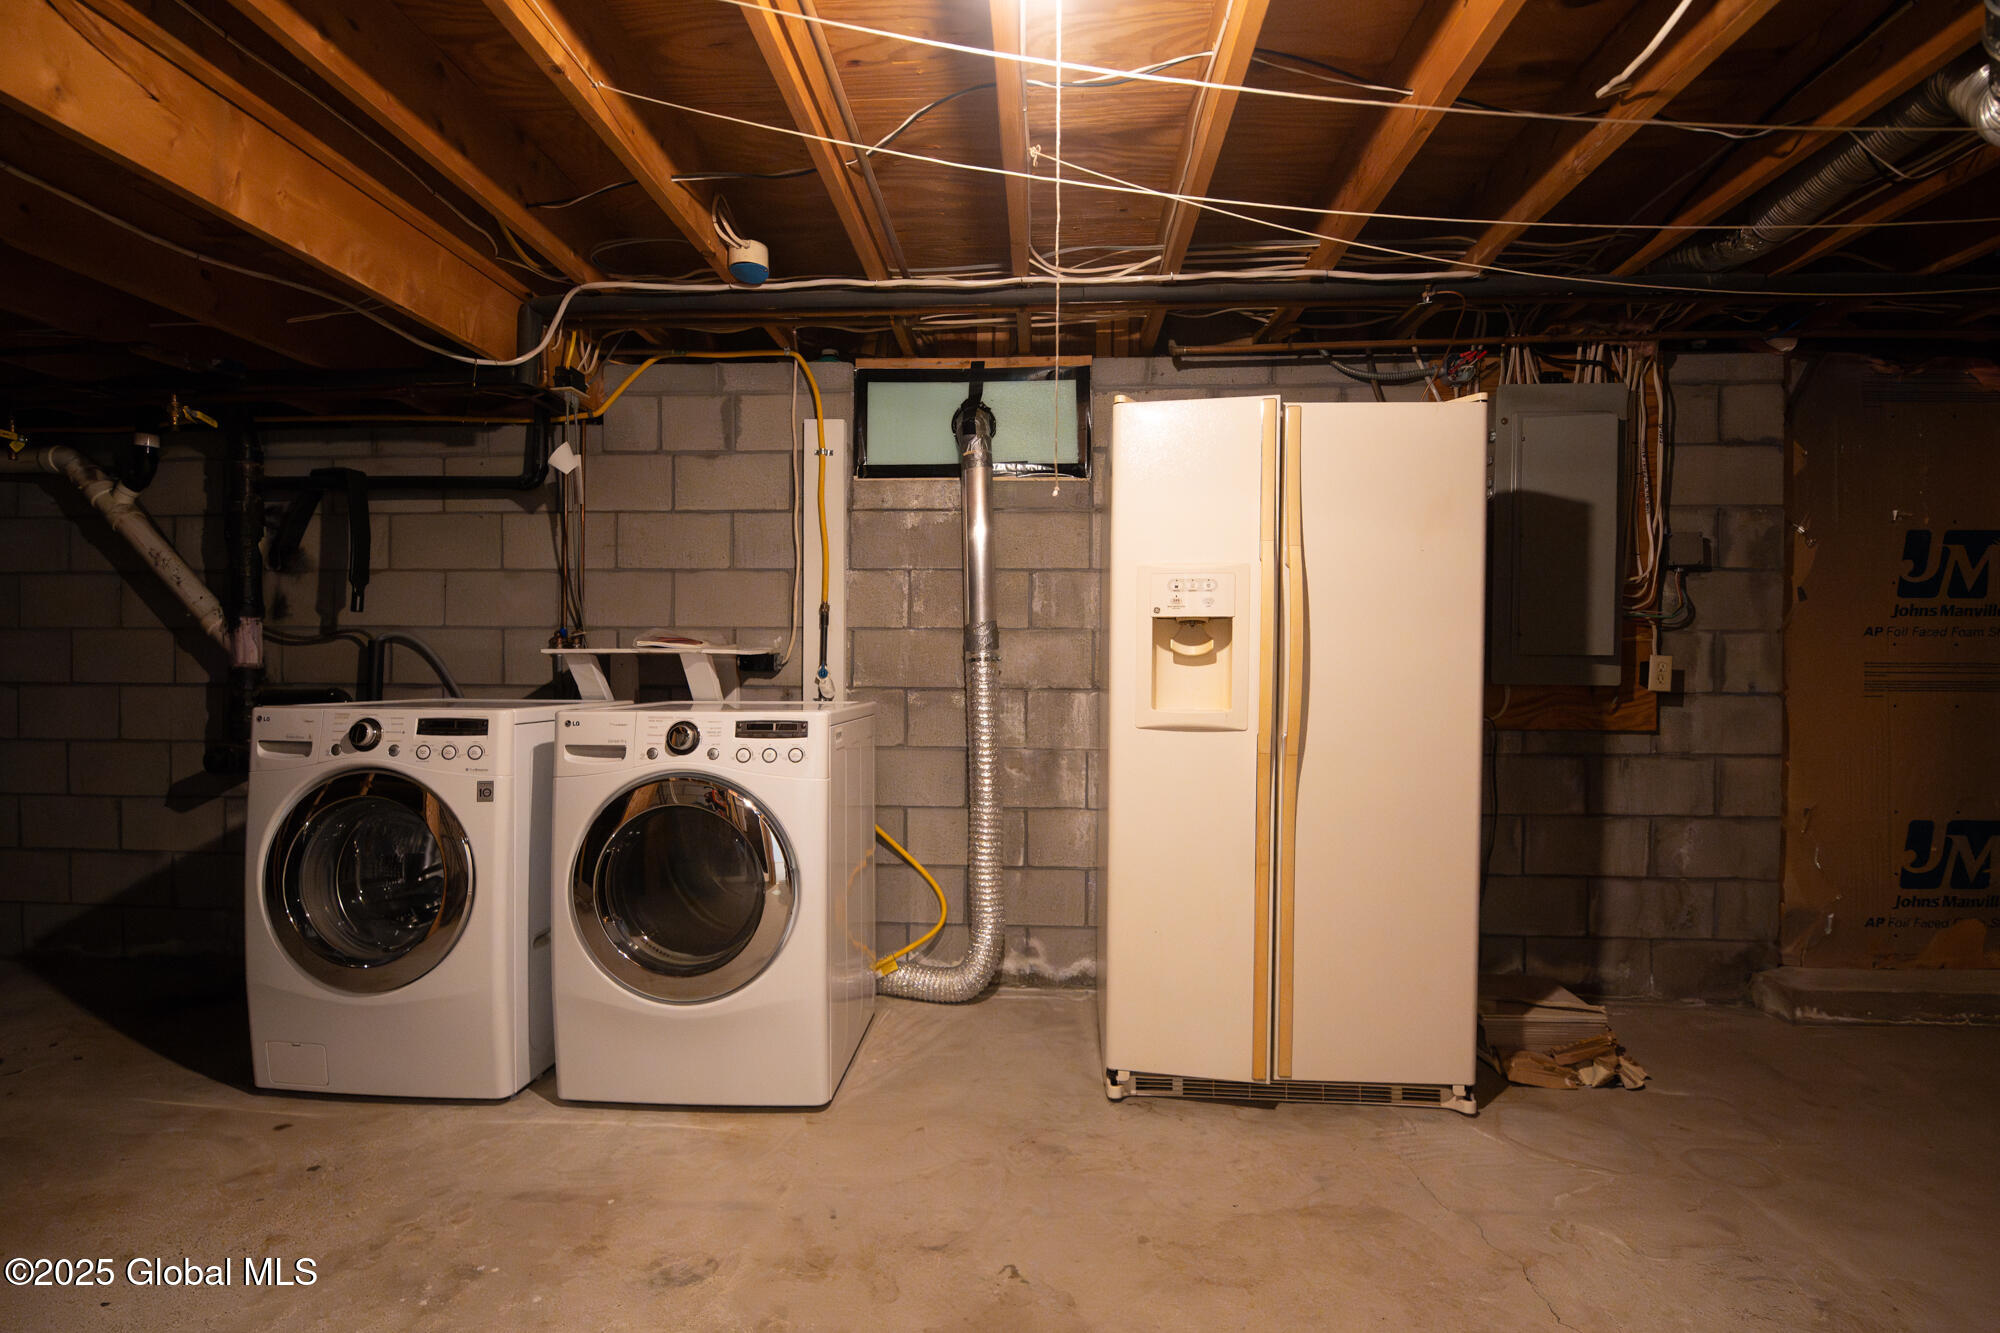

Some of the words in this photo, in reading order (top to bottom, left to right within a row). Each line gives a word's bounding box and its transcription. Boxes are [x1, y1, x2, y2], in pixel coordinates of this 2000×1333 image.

[1898, 530, 2000, 599] JM
[1890, 603, 1938, 618] Johns
[1864, 626, 1884, 636] AP
[1952, 626, 1985, 637] Foam
[1899, 819, 2000, 889] JM
[1892, 895, 1940, 909] Johns
[1864, 917, 1885, 928] AP
